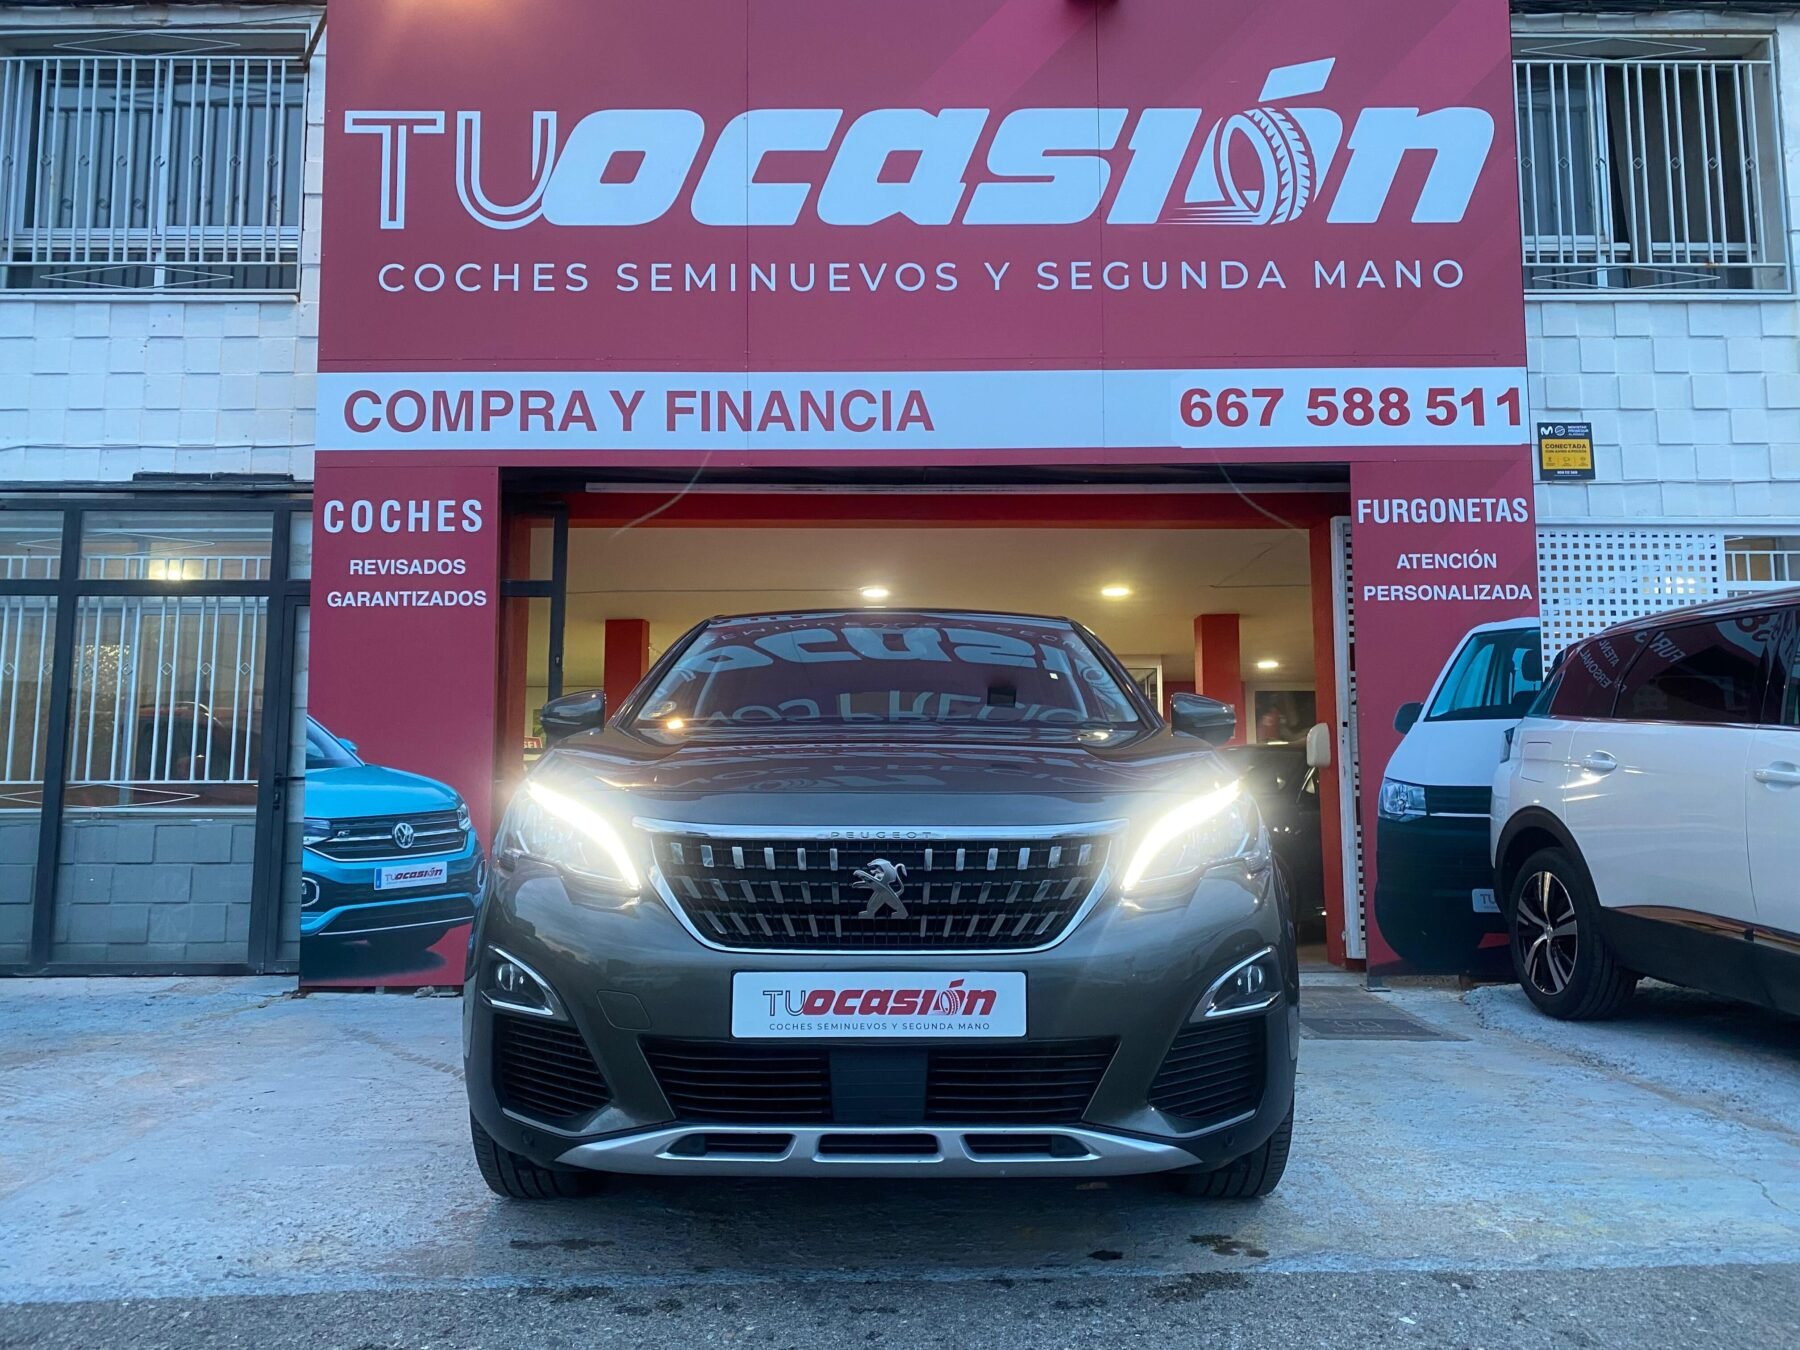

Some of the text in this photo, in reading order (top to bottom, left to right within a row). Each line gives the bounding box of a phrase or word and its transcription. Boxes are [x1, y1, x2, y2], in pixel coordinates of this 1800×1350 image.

[378, 259, 1465, 293] COCHES SEMINUEVOS Y SEGUNDA MANO
[343, 388, 935, 434] COMPRA Y FINANCIA
[1180, 386, 1521, 428] 667 588 511
[323, 499, 483, 534] COCHES
[1357, 497, 1529, 524] FURGONETAS
[349, 558, 467, 576] REVISADOS
[1396, 549, 1498, 569] ATENCIÓN
[327, 590, 488, 608] GARANTIZADOS
[1363, 584, 1533, 601] PERSONALIZADA
[830, 831, 932, 839] PEUGEOT
[769, 1022, 991, 1031] COCHES SEMINUEVOS Y SEGUNDA MANO
